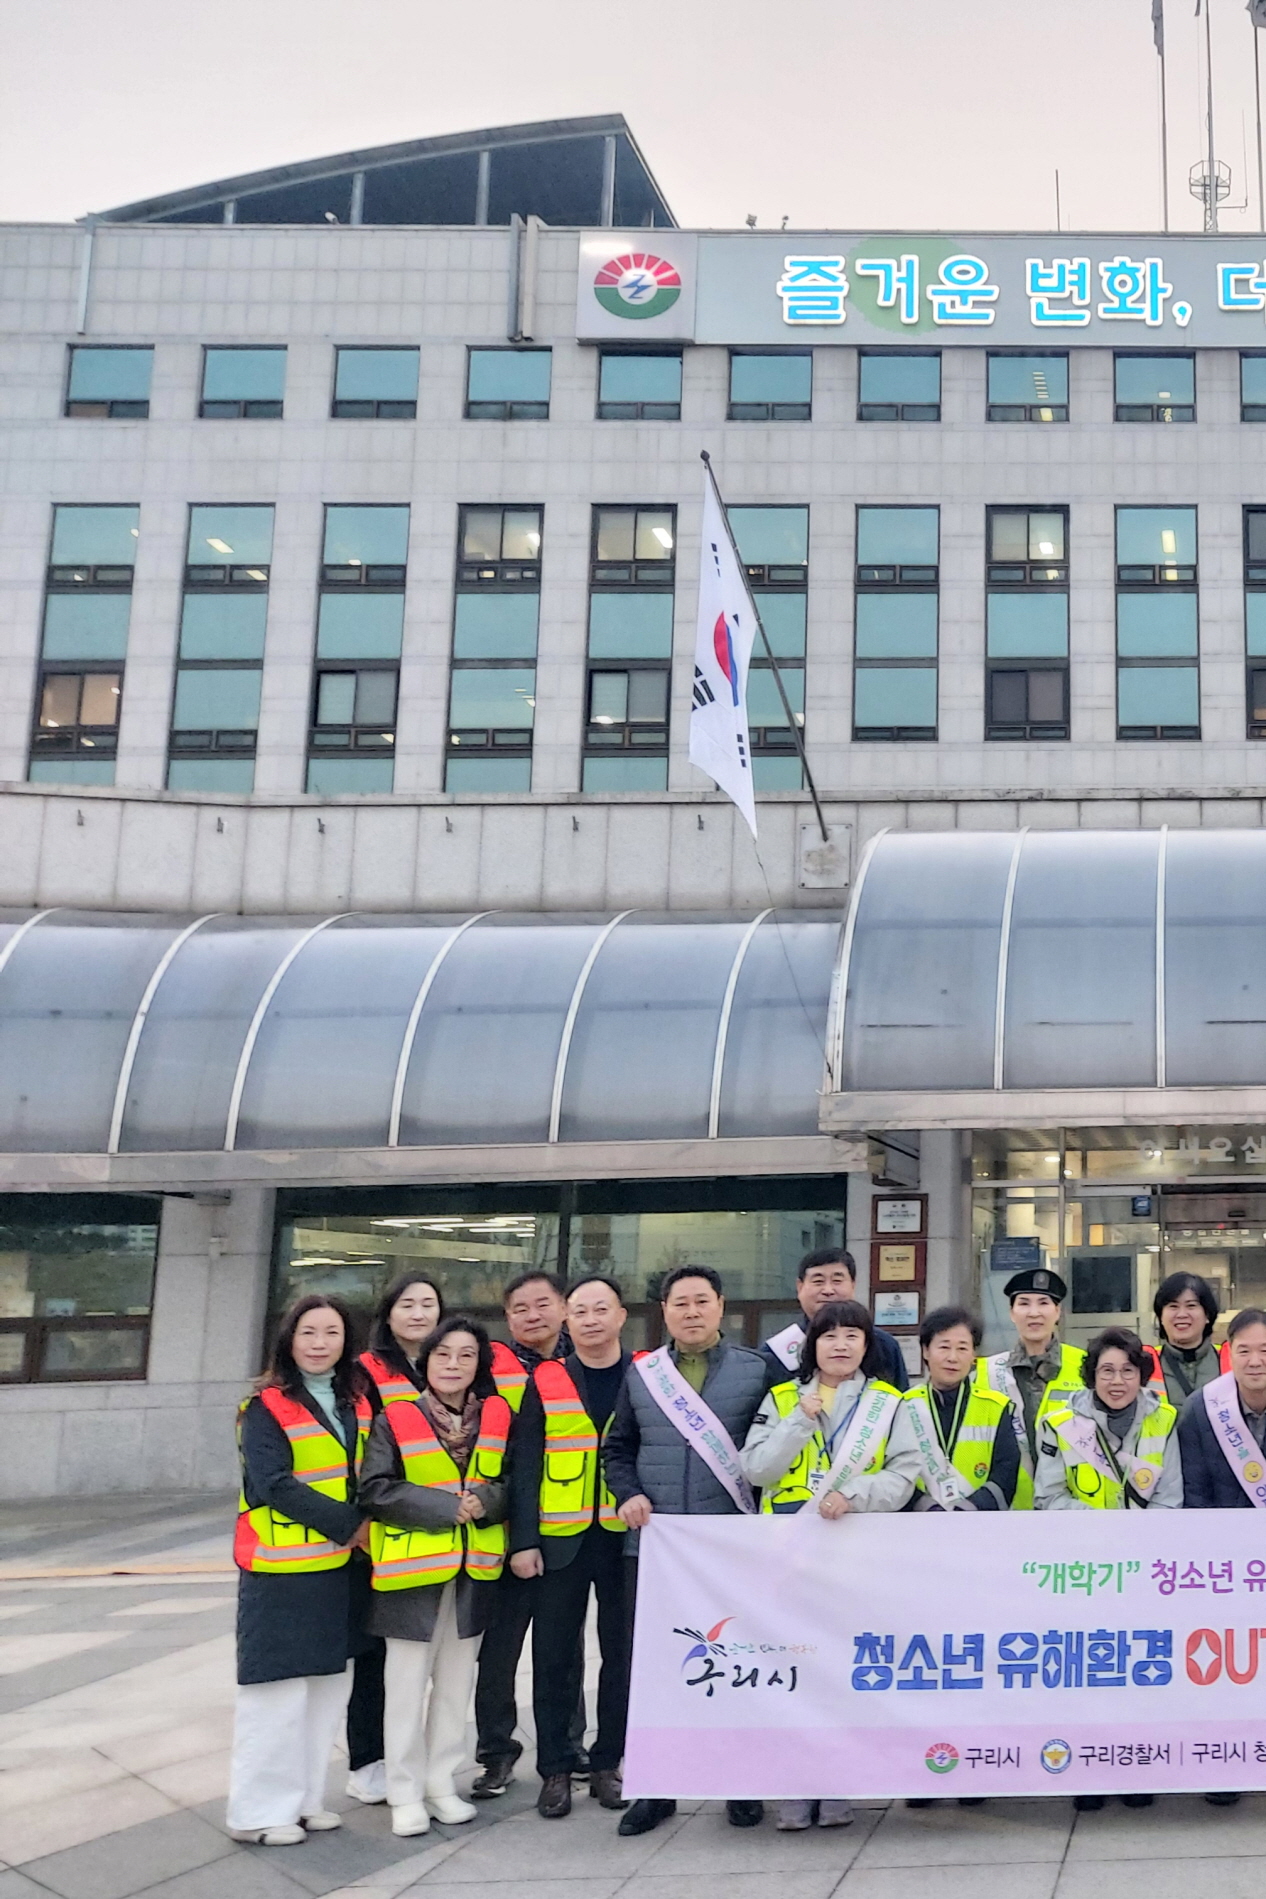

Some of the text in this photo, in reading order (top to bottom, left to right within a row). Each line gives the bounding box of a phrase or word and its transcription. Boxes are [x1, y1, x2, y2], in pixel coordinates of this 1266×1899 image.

[777, 255, 999, 325] 즐거운
[1025, 256, 1192, 326] 변화,
[848, 1421, 875, 1465] 청소년
[1021, 1560, 1142, 1597] “개학기”
[1150, 1558, 1235, 1596] 청소년
[685, 1657, 798, 1698] 구리시
[851, 1631, 984, 1691] 청소년
[997, 1628, 1174, 1690] 유해환경
[964, 1745, 1021, 1769] 구리시
[1078, 1743, 1171, 1768] 구리경찰서
[1191, 1741, 1247, 1764] 구리시
